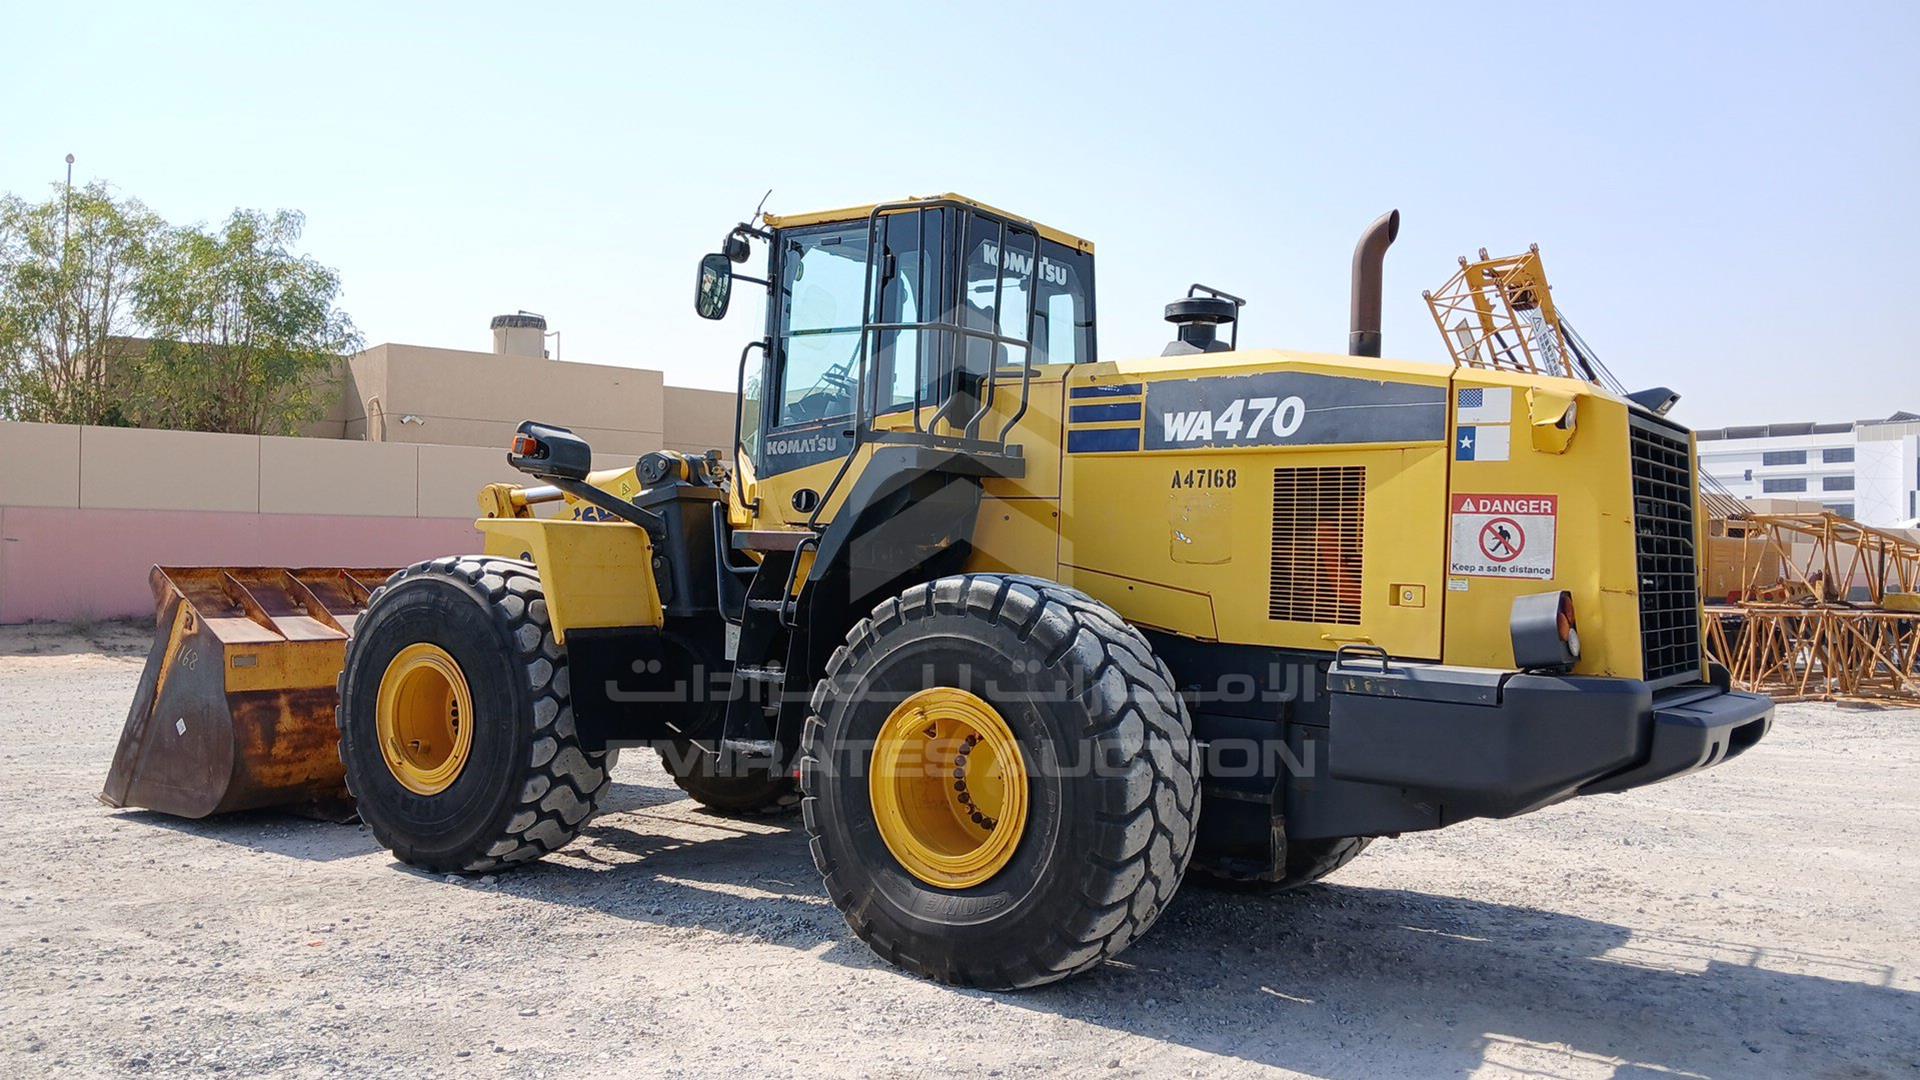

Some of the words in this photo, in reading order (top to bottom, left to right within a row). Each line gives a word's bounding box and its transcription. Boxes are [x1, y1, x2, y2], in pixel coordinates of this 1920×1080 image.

[1164, 396, 1306, 442] WA470
[767, 434, 837, 456] KOMATSU
[1171, 469, 1237, 489] A47168
[1479, 499, 1553, 514] DANGER
[1452, 563, 1476, 573] Keep
[1486, 565, 1507, 573] safe
[1509, 565, 1551, 575] distance
